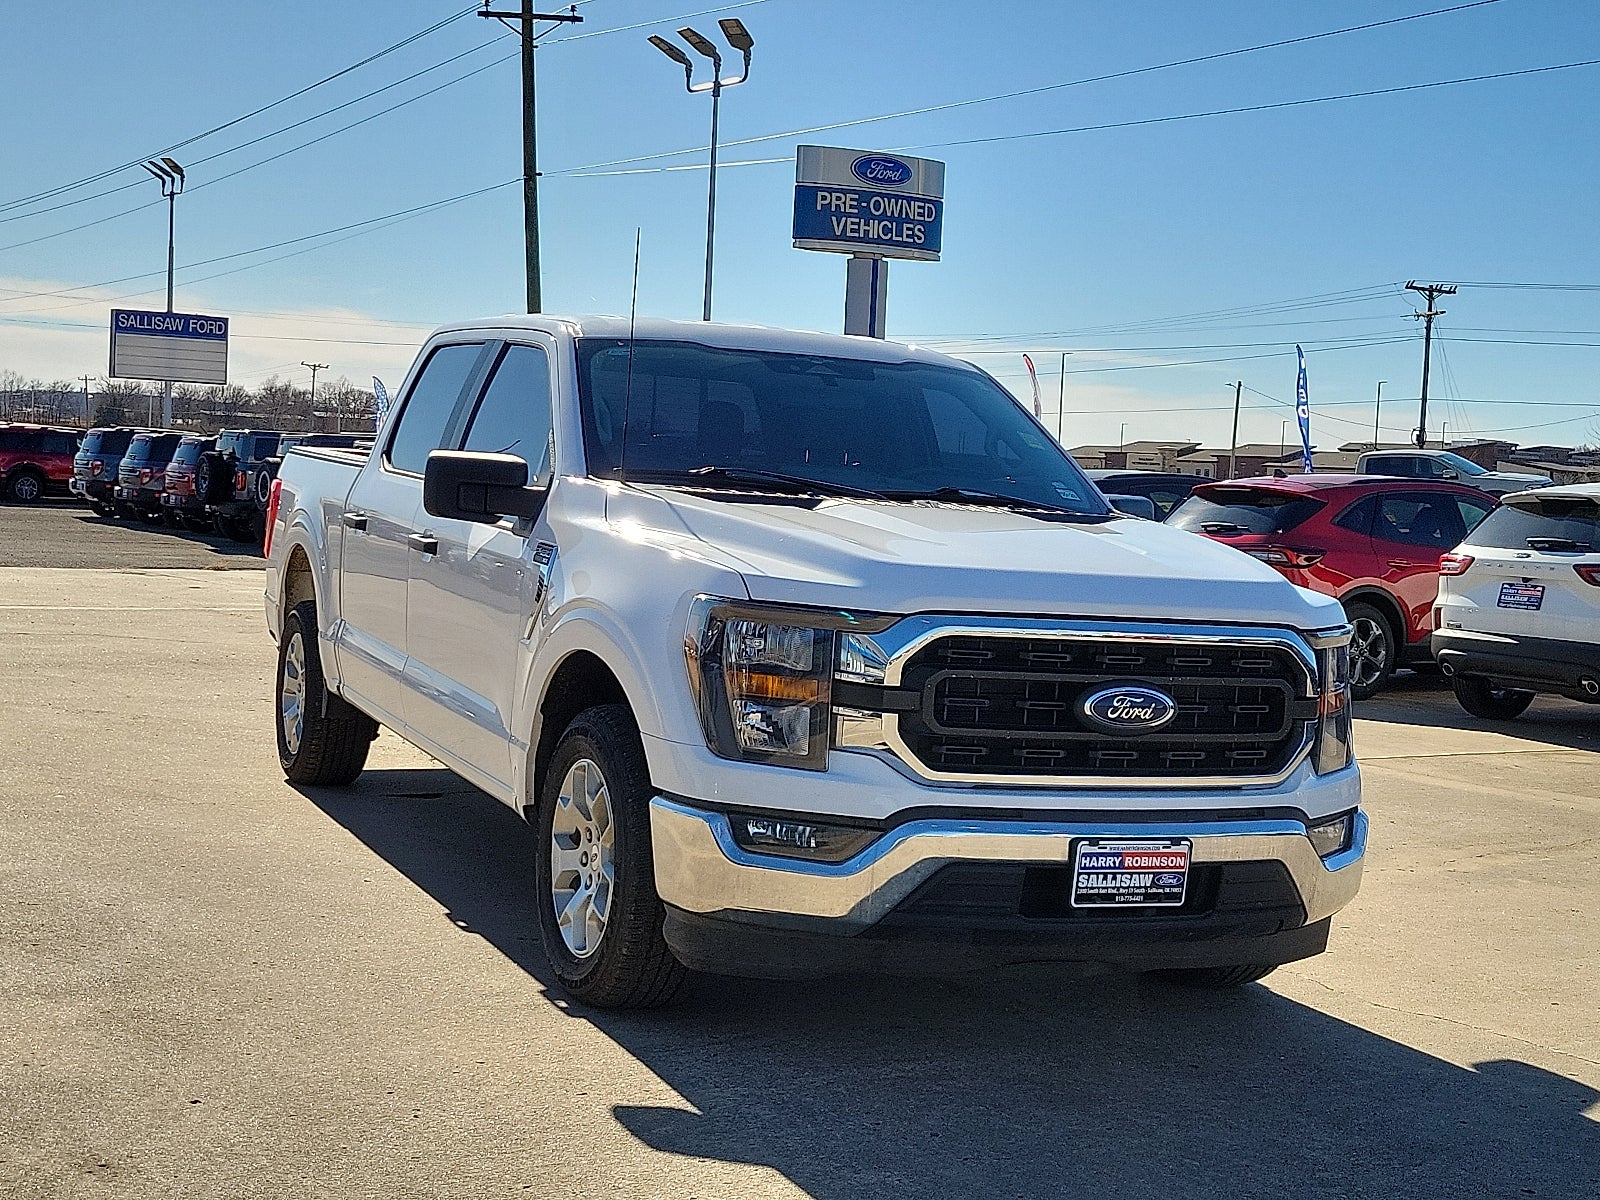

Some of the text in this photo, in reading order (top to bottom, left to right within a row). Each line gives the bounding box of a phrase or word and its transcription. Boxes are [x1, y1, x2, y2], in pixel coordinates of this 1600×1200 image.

[866, 160, 903, 181] Ford
[816, 191, 936, 222] PRE-OWNED
[831, 216, 925, 244] VEHICLES
[118, 313, 226, 335] SALLISAW FORD
[1107, 695, 1156, 720] Ford
[1081, 856, 1185, 868] HARRY ROBINSON
[1078, 873, 1154, 888] SALLISAW
